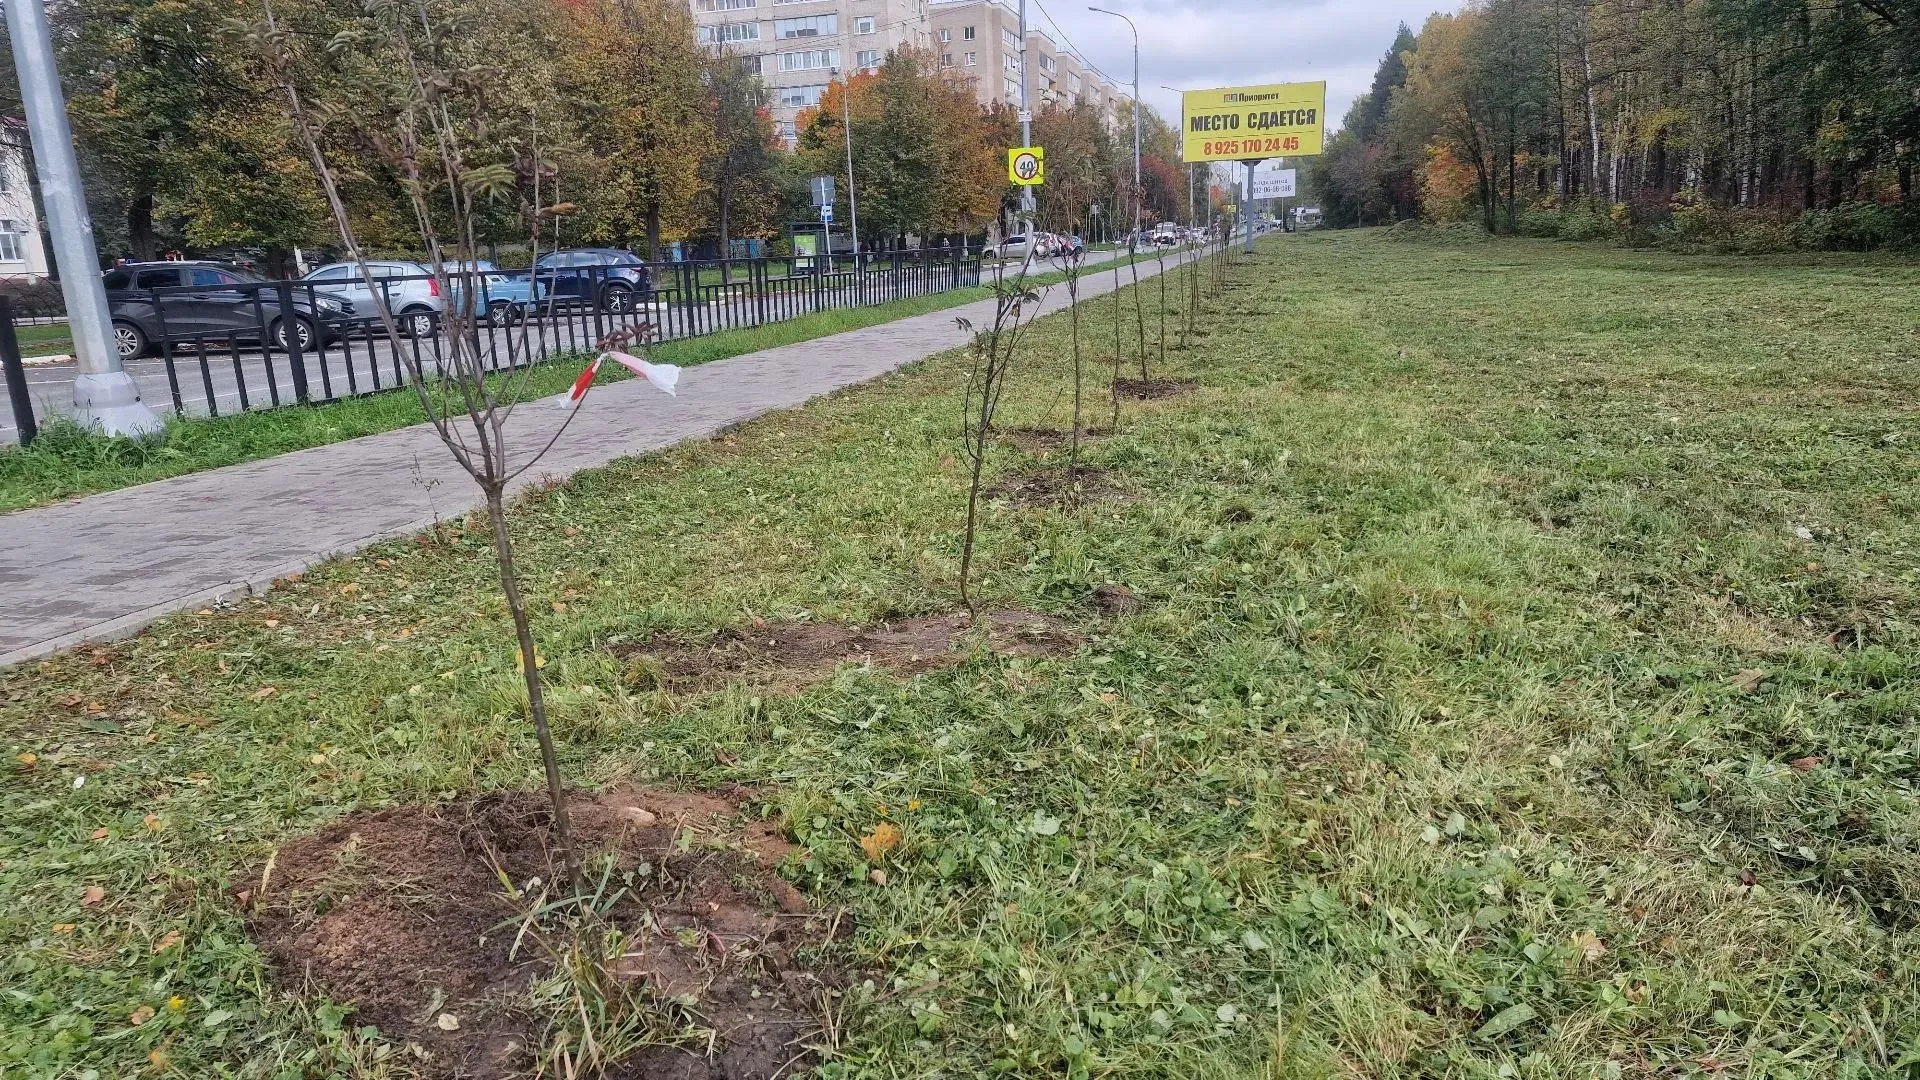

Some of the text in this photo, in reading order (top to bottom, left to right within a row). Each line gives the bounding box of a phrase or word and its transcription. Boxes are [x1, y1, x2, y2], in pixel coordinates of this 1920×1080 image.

[1239, 92, 1279, 102] Приоритет
[1191, 108, 1317, 132] МЕСТО СДАЕТСЯ
[1203, 136, 1299, 156] 8 925 170 24 45
[1019, 161, 1034, 171] 40
